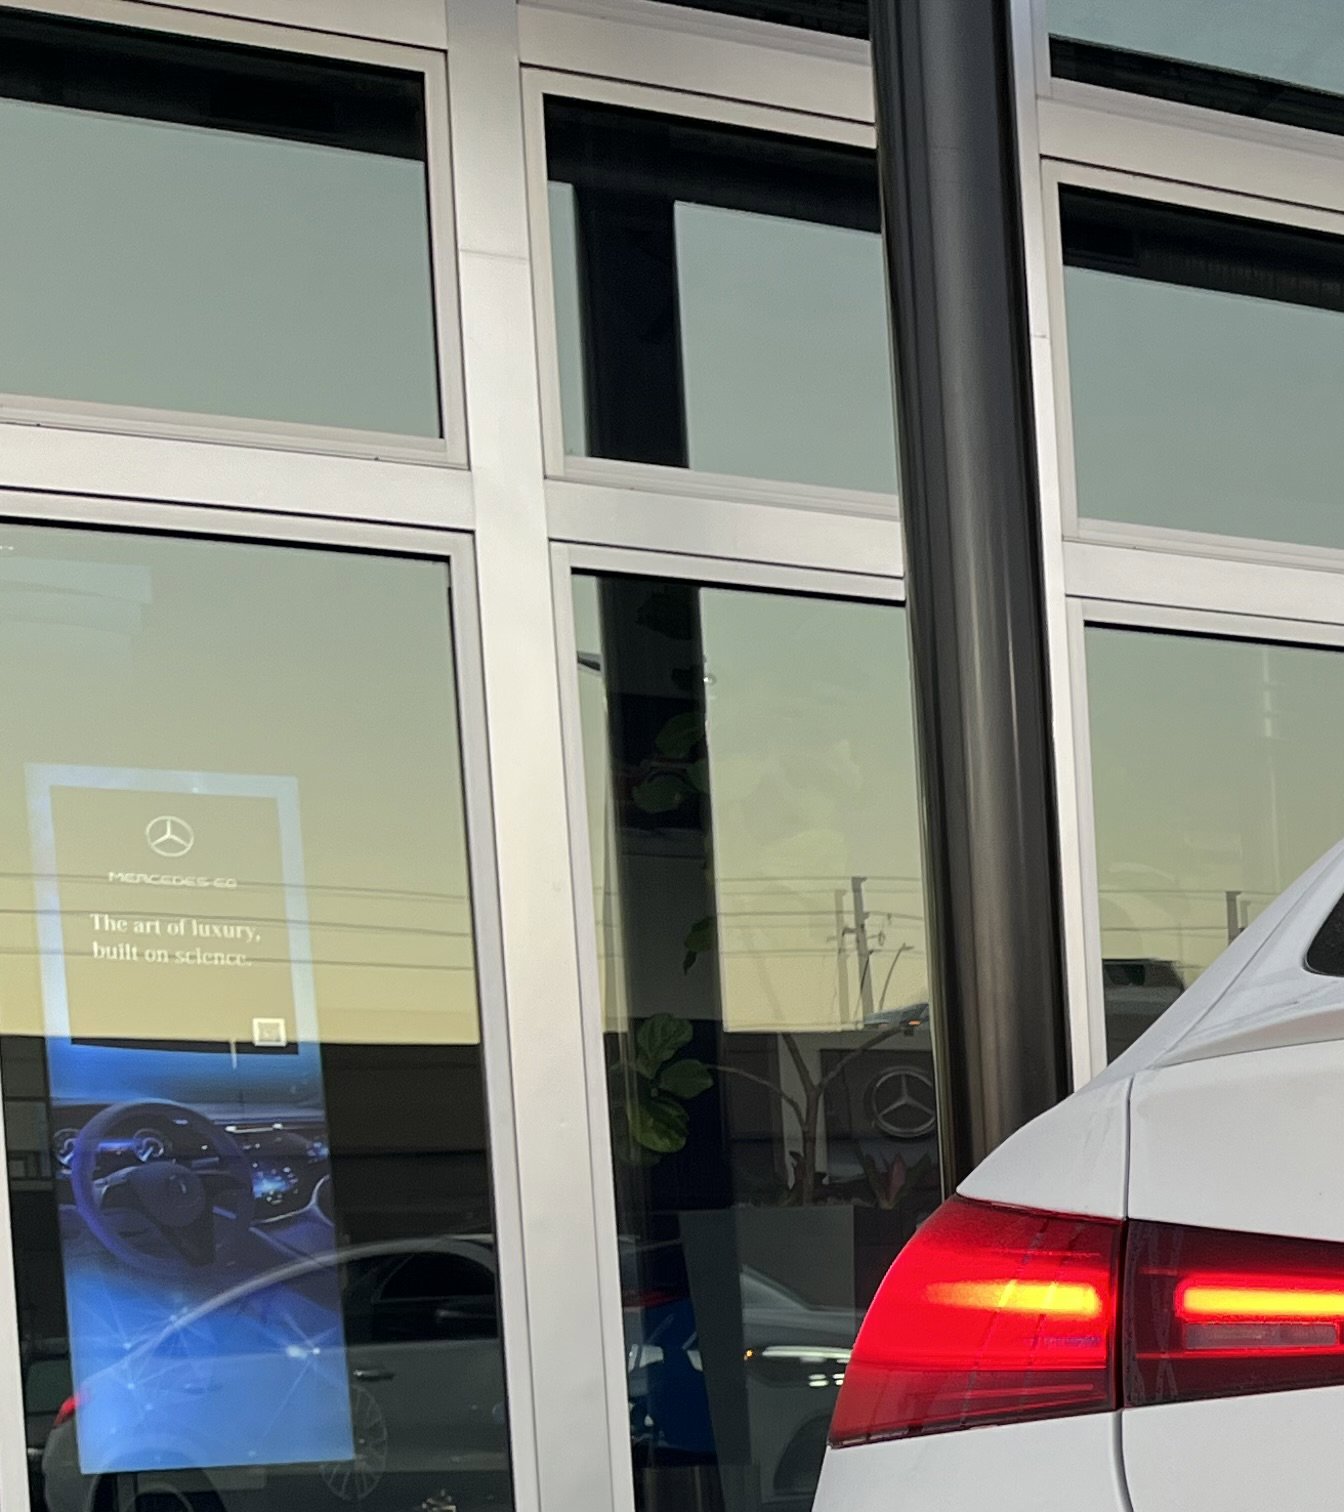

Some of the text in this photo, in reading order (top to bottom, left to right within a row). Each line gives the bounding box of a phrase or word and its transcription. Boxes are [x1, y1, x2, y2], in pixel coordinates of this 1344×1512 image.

[90, 913, 261, 943] The art of luxury,
[92, 941, 252, 966] built on science.
